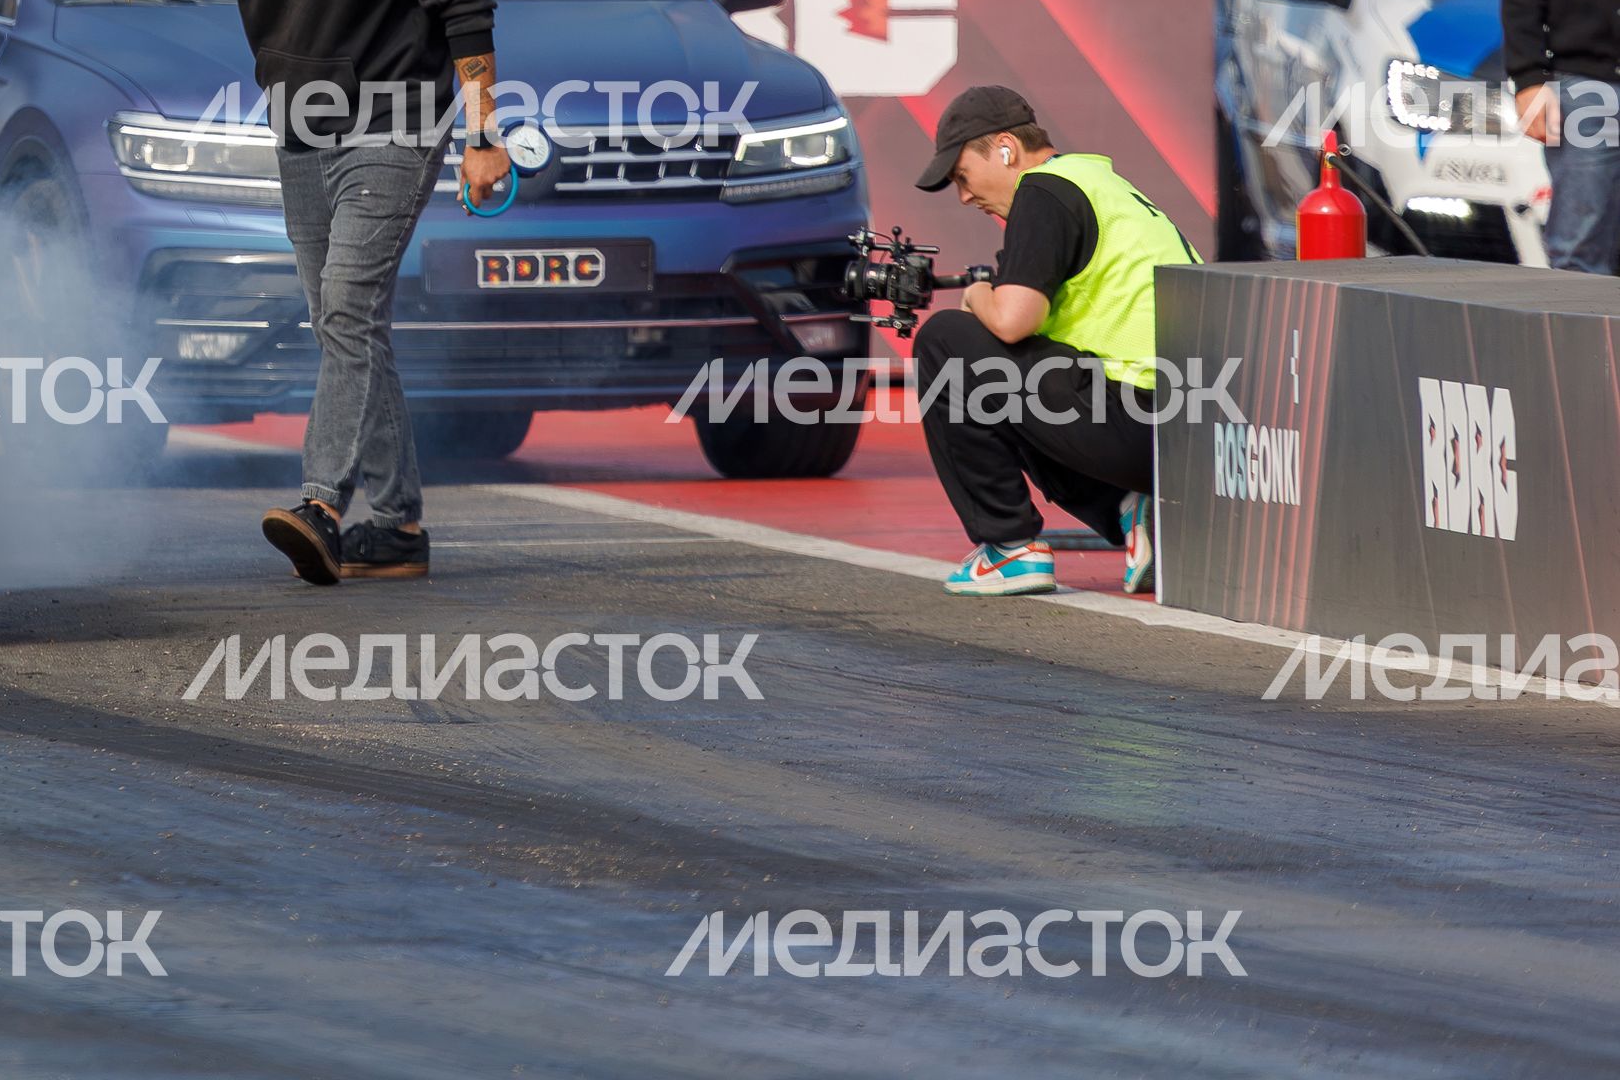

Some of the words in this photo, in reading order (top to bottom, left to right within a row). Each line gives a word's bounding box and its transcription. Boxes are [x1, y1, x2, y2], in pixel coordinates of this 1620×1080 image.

[474, 247, 606, 289] RDRC
[1214, 421, 1301, 506] ROSGONKI
[1418, 376, 1519, 542] RDRC
